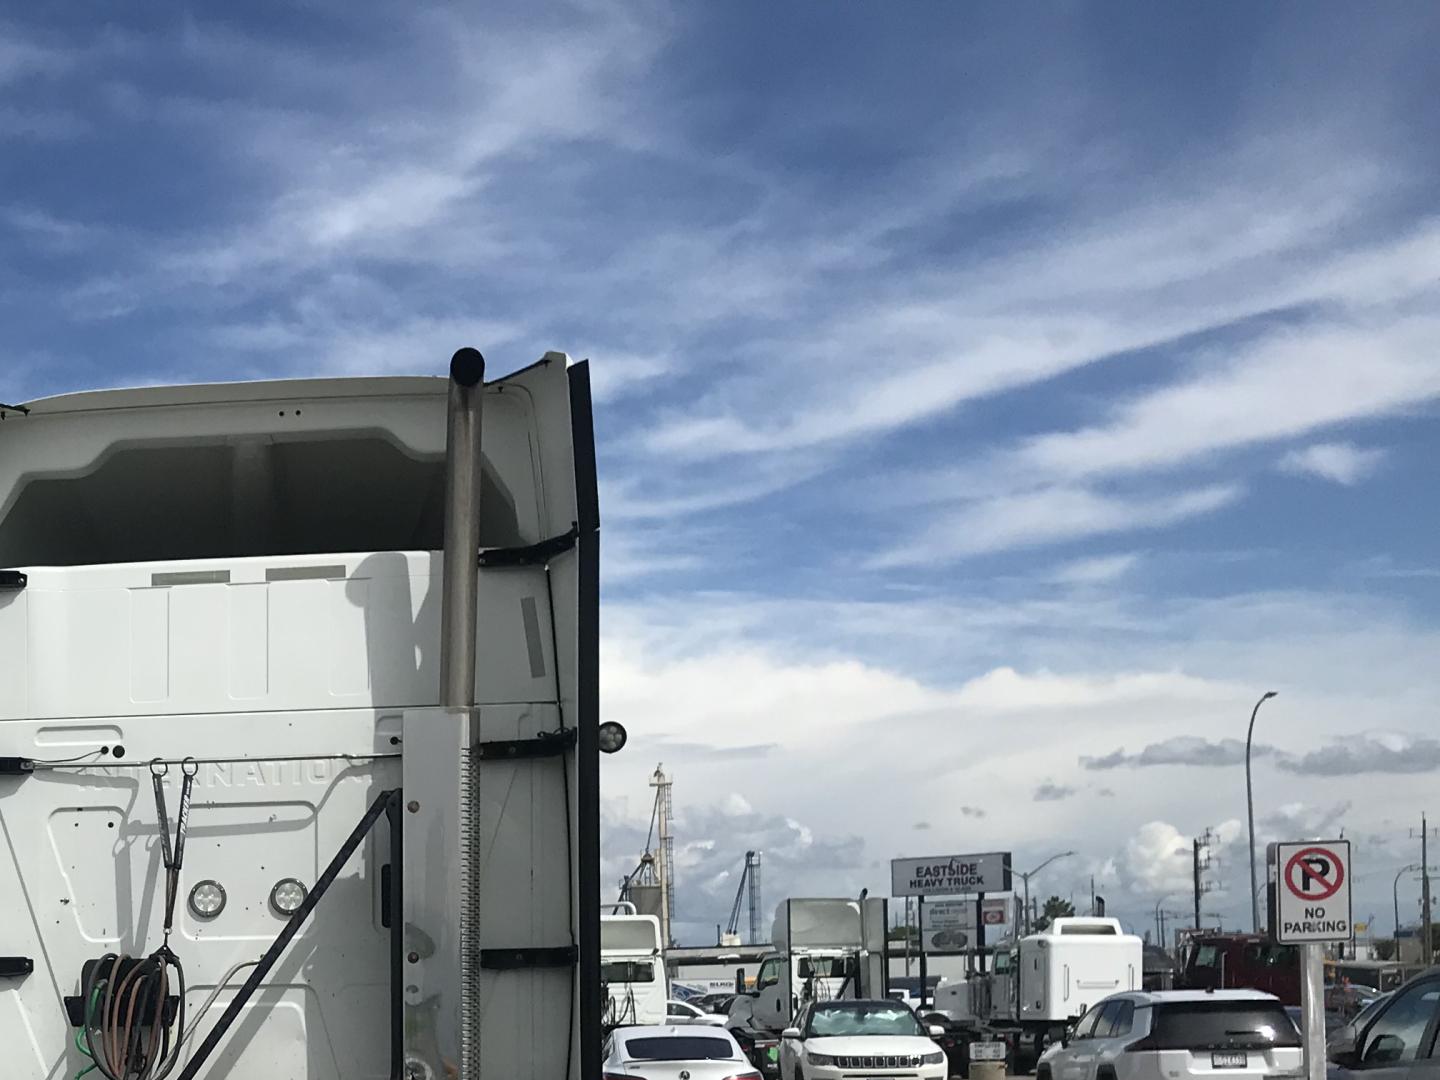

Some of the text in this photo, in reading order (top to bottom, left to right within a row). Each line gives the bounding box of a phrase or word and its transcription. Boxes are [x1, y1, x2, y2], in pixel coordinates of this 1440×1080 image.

[916, 864, 977, 878] EASTSIDE
[909, 878, 944, 889] HEAVY
[946, 876, 985, 886] TRUCK
[1304, 907, 1326, 919] NO
[1284, 920, 1347, 934] PARKING
